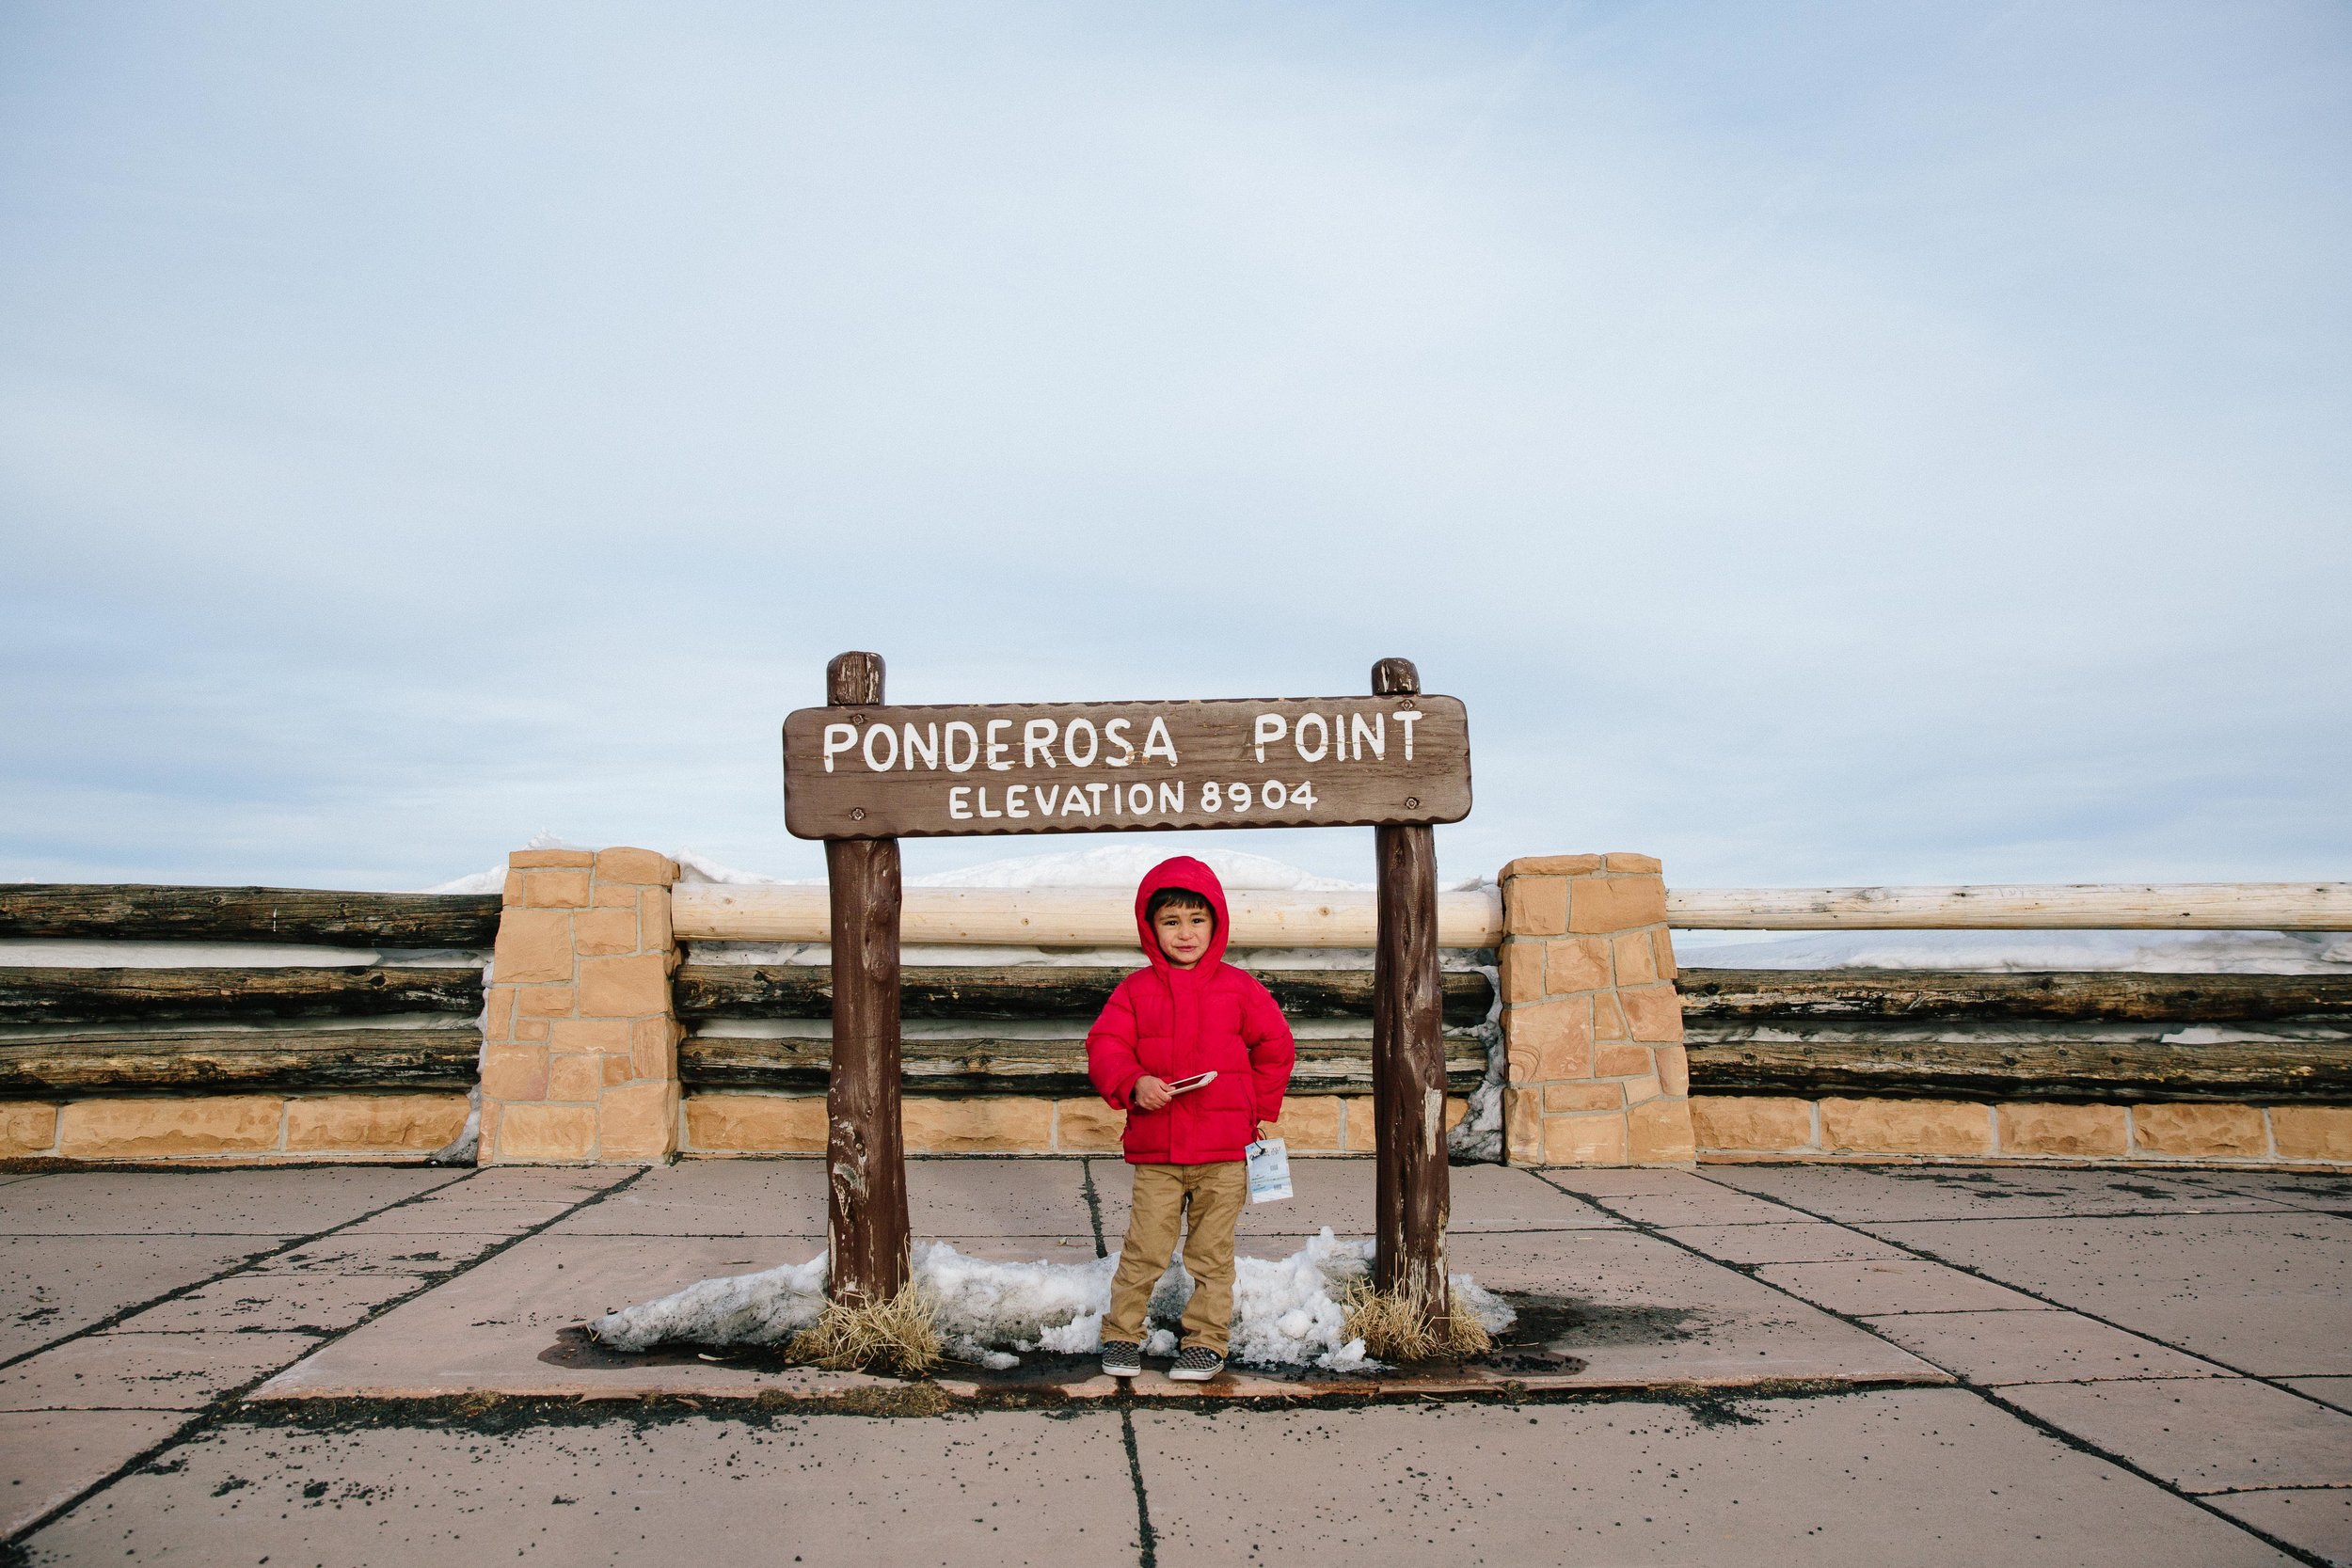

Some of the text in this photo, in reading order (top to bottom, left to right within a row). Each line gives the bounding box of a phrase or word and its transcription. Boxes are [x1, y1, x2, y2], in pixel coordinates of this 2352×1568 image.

[822, 711, 1423, 773] PONDEROSA POINT
[948, 779, 1319, 820] ELEVATION 8904
